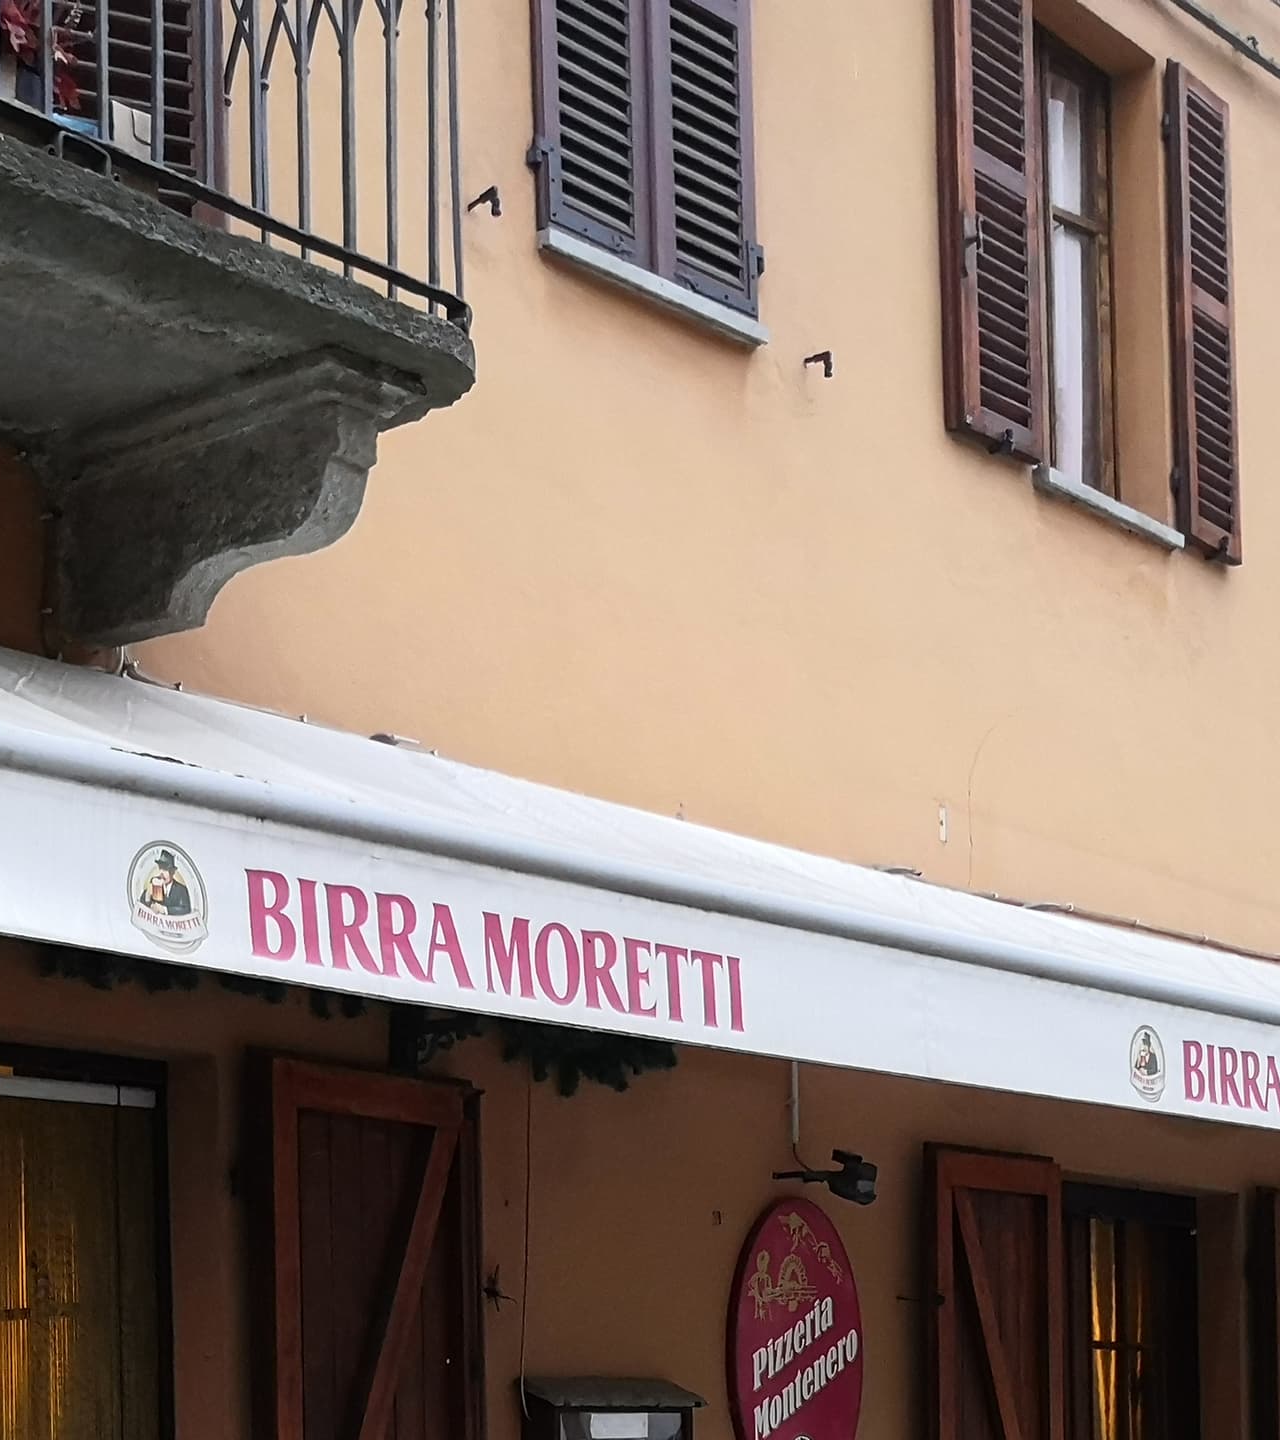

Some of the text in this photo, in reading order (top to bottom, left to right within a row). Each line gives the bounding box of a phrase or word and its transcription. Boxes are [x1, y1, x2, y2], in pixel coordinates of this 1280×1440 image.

[137, 907, 201, 931] BIRRA MORETTI
[244, 868, 745, 1033] BIRRA MORETTI
[752, 1296, 834, 1392] Pizzeria
